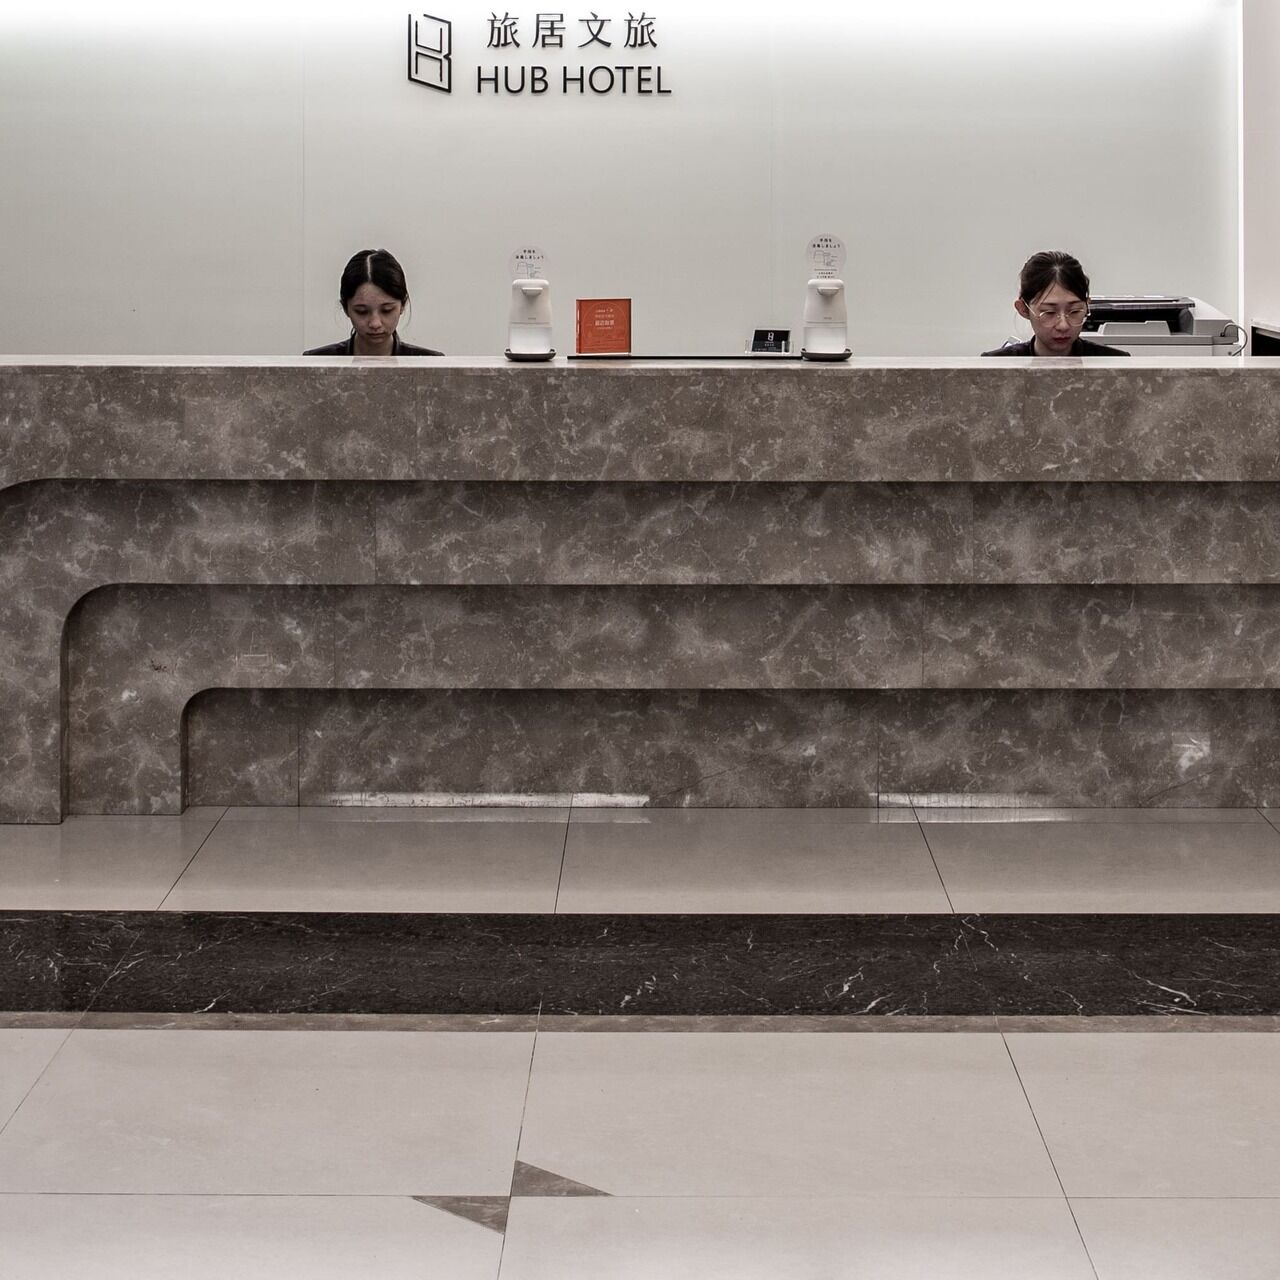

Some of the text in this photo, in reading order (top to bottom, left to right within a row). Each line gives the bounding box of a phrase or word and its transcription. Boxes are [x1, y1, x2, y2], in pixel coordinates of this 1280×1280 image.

[486, 11, 658, 49] 旅居文旅
[477, 66, 672, 94] HUB HOTEL
